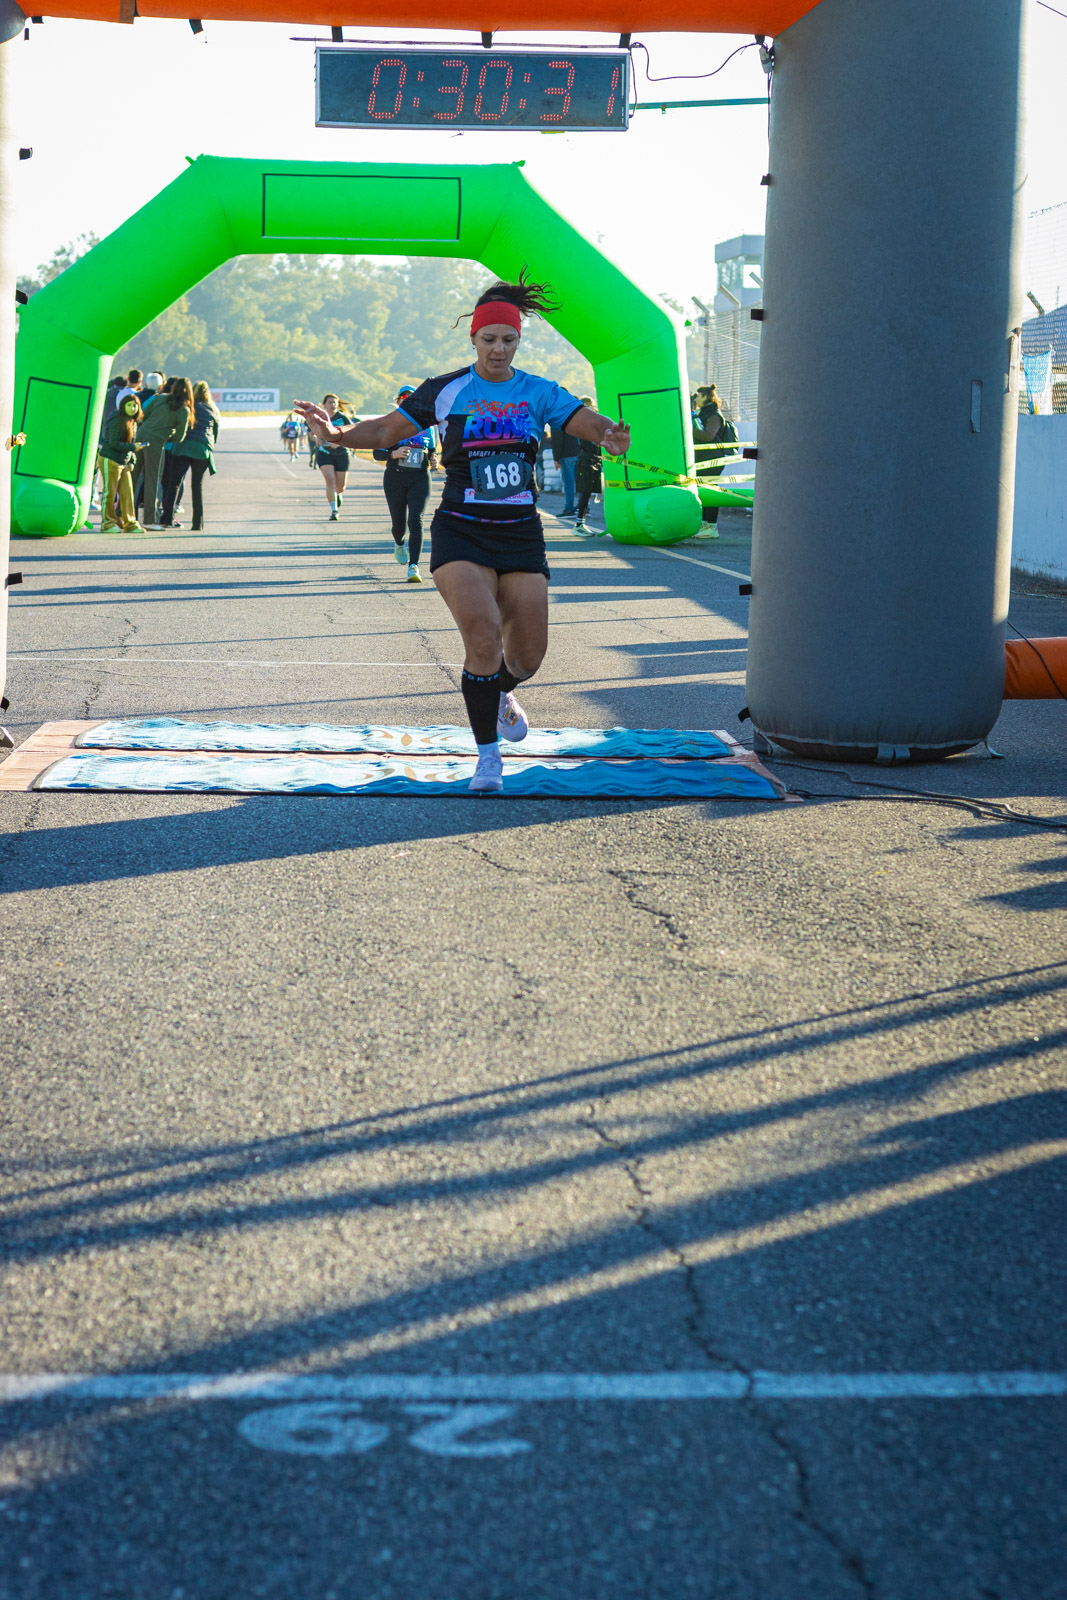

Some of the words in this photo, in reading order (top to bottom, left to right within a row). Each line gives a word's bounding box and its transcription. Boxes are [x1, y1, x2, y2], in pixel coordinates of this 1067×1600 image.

[368, 59, 619, 120] 0:30:31
[225, 393, 271, 401] LONG
[463, 415, 523, 440] RUN
[484, 462, 521, 489] 168
